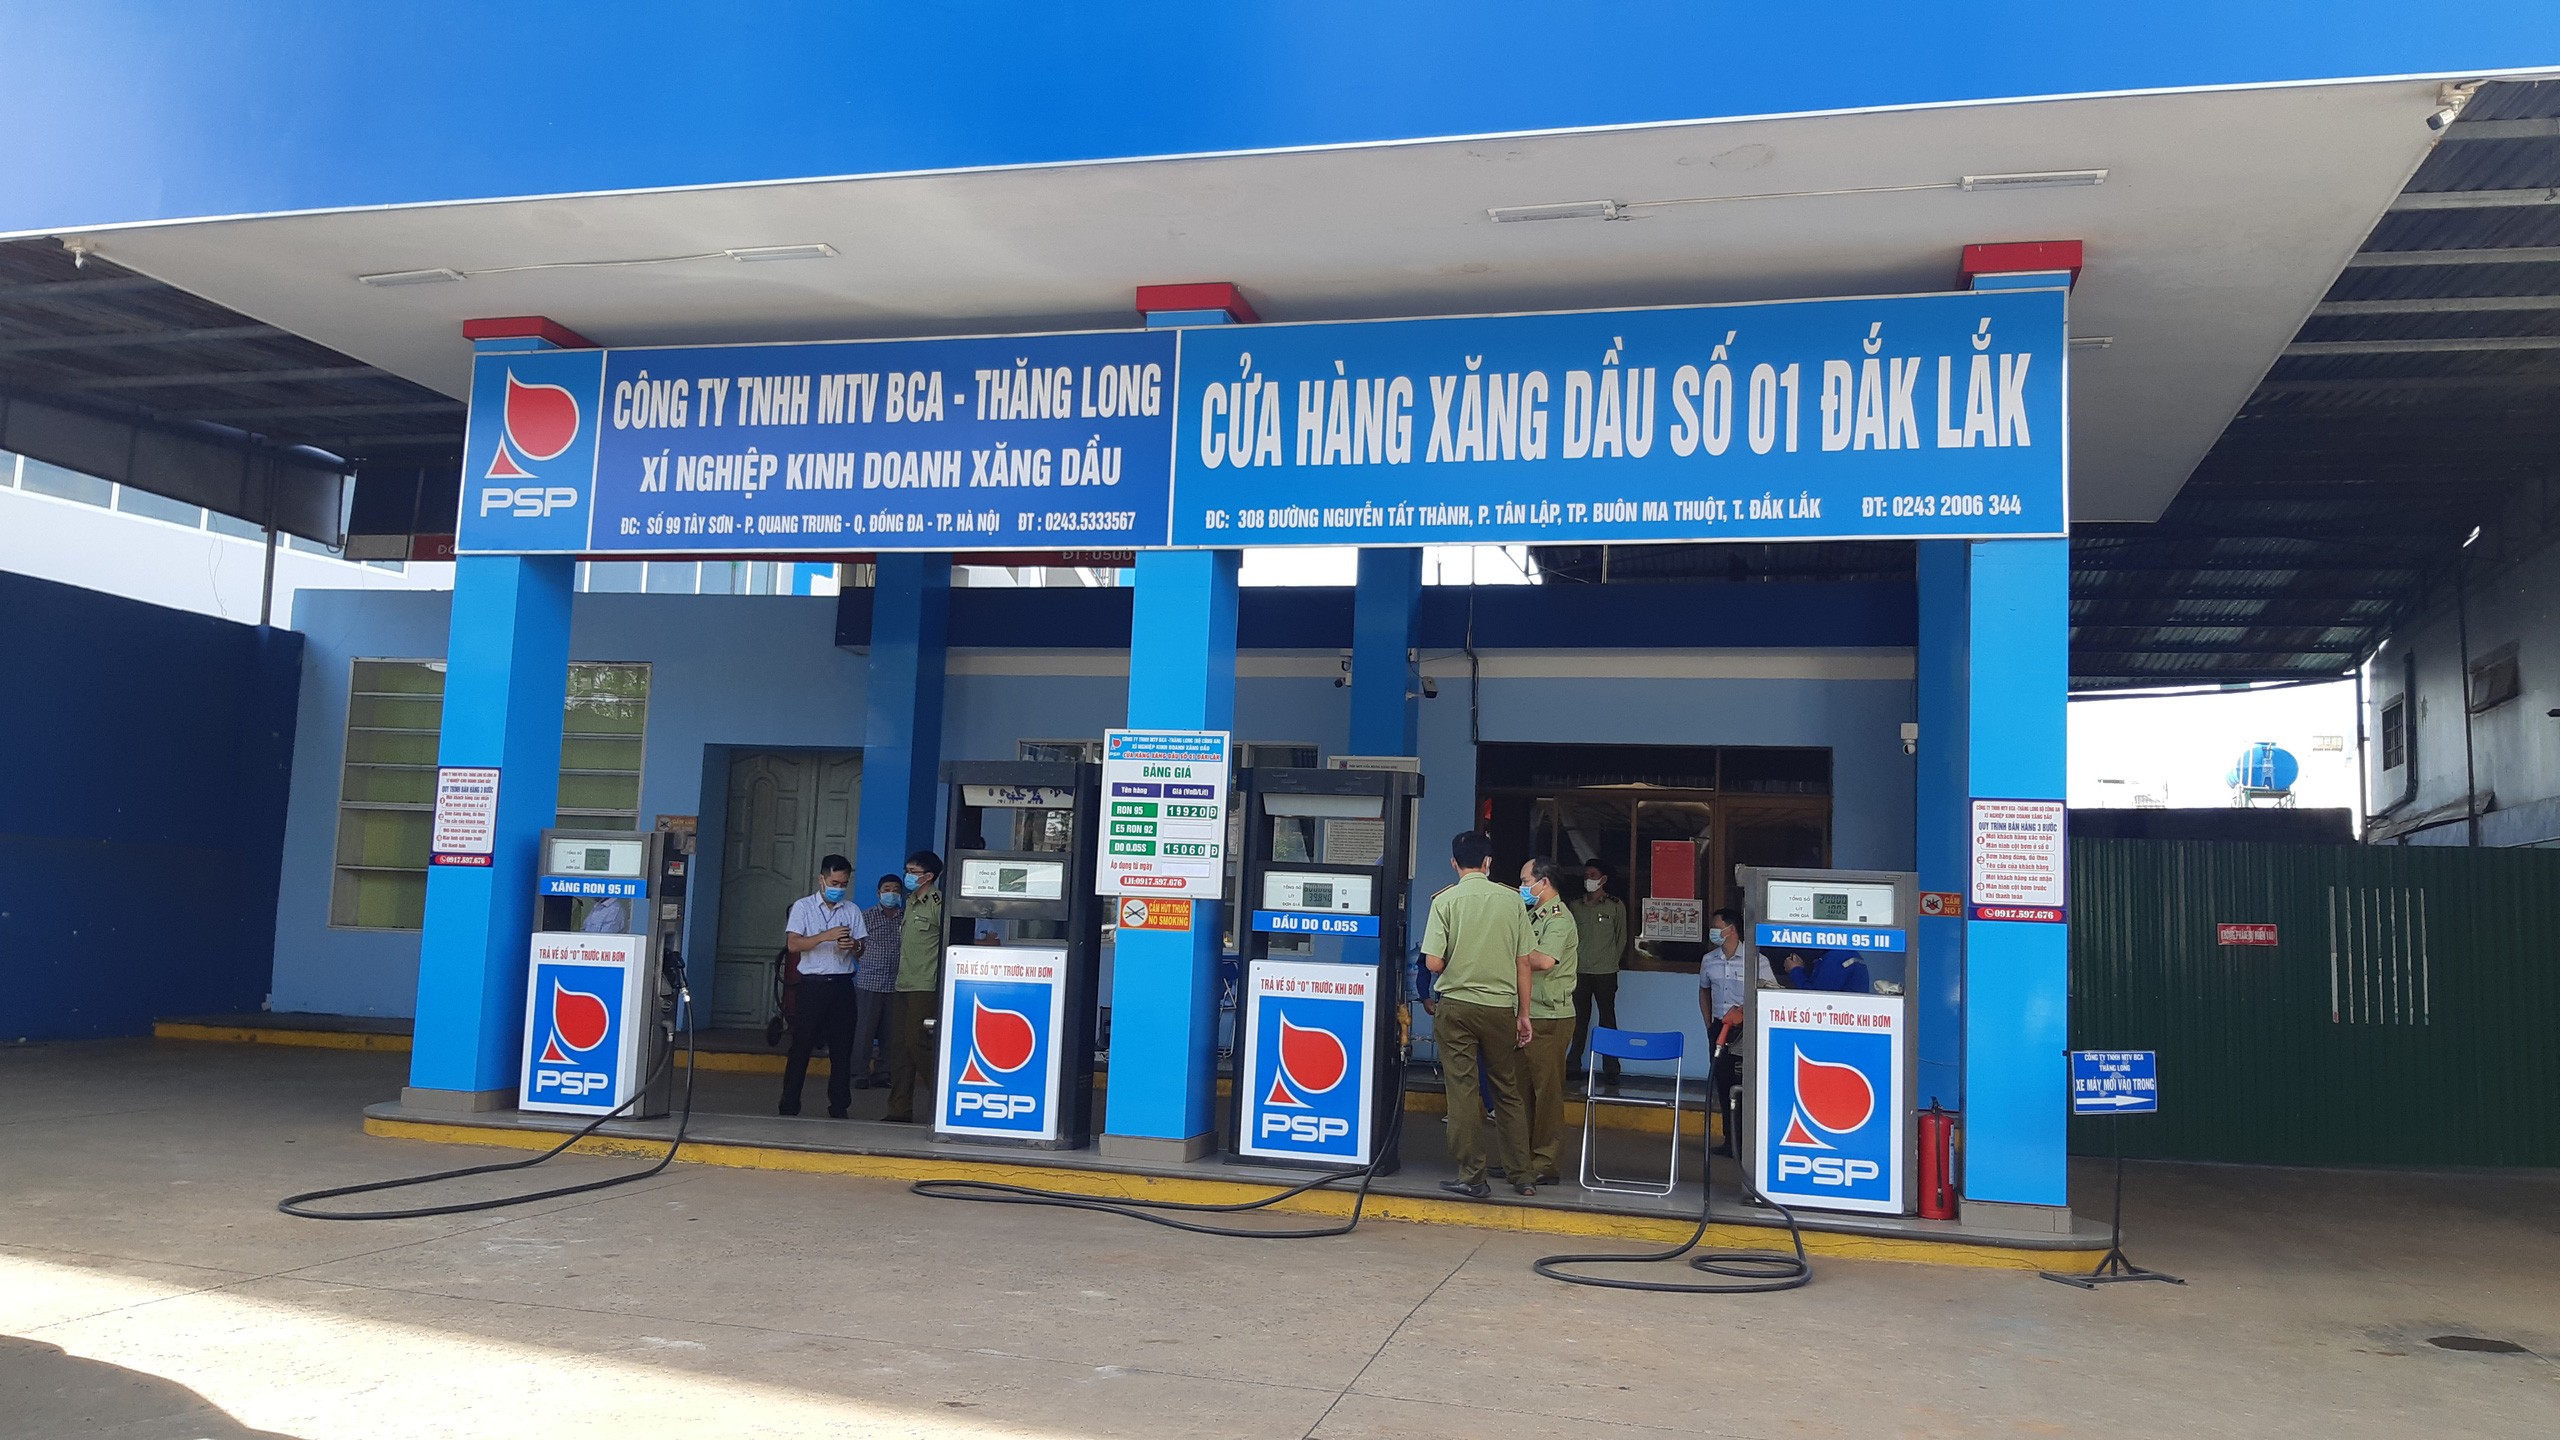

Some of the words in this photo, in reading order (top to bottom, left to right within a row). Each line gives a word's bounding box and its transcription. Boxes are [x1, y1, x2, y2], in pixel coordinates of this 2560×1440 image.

[613, 369, 689, 430] CÔNG
[698, 377, 731, 427] TY
[737, 374, 811, 427] TNHH
[818, 373, 880, 424] MTV
[886, 371, 944, 423] BCA
[975, 357, 1072, 421] THĂNG
[1081, 363, 1162, 418] LONG
[1200, 352, 1283, 469] CỬA
[1296, 360, 1414, 466] HÀNG
[1425, 354, 1549, 463] XĂNG
[1562, 337, 1656, 459] DẦU
[1669, 330, 1738, 457] SỐ
[1748, 362, 1799, 455] 01
[1820, 321, 1921, 451] ĐẮK
[1937, 317, 2032, 448] LẮK
[640, 448, 671, 492] XÍ
[675, 446, 778, 499] NGHIỆP
[786, 451, 856, 491] KINH
[862, 450, 962, 489] DOANH
[969, 441, 1052, 488] XĂNG
[1060, 433, 1122, 486] DẦU
[480, 487, 578, 517] PSP
[1205, 510, 1230, 529] ĐC:
[1237, 509, 1265, 529] 308
[1268, 503, 1319, 529] ĐƯỜNG
[1323, 499, 1382, 528] NGUYỄN
[1388, 500, 1414, 527] TẤT
[1419, 502, 1473, 528] THÀNH,
[1478, 505, 1491, 526] P.
[1495, 500, 1526, 525] TÂN
[1529, 499, 1562, 529] LẬP,
[1566, 502, 1589, 523] TP.
[1592, 498, 1638, 522] BUÔN
[1641, 500, 1669, 522] MA
[1673, 496, 1729, 525] THUỘT,
[1733, 499, 1744, 521] T.
[1748, 491, 1784, 520] ĐẮK
[1788, 489, 1821, 519] LẮK
[1862, 495, 1887, 518] ĐT:
[1892, 494, 1936, 517] 0243
[1940, 494, 1984, 516] 2006
[1988, 494, 2022, 515] 344
[620, 516, 641, 535] ĐC:
[646, 510, 664, 535] SỐ
[666, 516, 681, 534] 99
[683, 512, 707, 534] TÂY
[708, 514, 734, 534] SƠN
[744, 515, 755, 534] P.
[757, 515, 800, 534] QUANG
[802, 513, 843, 533] TRUNG
[854, 513, 866, 534] Q.
[869, 508, 904, 533] ĐỐNG
[906, 513, 924, 532] ĐA
[936, 512, 953, 532] TP.
[956, 509, 973, 532] HÀ
[977, 509, 1000, 535] NỘI
[1018, 512, 1034, 532] ĐT
[1045, 511, 1136, 532] 0243.5333567
[1143, 763, 1171, 778] BẢNG
[1174, 764, 1192, 779] GIÁ
[1116, 805, 1132, 815] RON
[1134, 806, 1144, 815] 95
[1168, 806, 1206, 817] 19920
[1115, 824, 1125, 833] E5
[1126, 824, 1142, 834] RON
[1143, 825, 1154, 834] 92
[1978, 822, 1989, 831] QUY
[1991, 820, 2007, 831] TRÌNH
[2008, 821, 2020, 831] BÁN
[2021, 821, 2036, 832] HÀNG
[2042, 822, 2058, 832] BƯỚC
[1114, 842, 1125, 852] DO
[1126, 843, 1147, 852] 0.05S
[1165, 844, 1205, 855] 15060
[551, 880, 580, 894] XĂNG
[583, 883, 606, 894] RON
[608, 884, 621, 895] 95
[624, 884, 635, 895] III
[1149, 900, 1160, 913] CẤM
[1161, 901, 1172, 913] HÚT
[1172, 900, 1189, 914] THUỐC
[1994, 909, 2054, 919] 0917.597.676
[1148, 915, 1158, 925] NO
[1159, 915, 1189, 927] SMOKING
[1272, 914, 1298, 930] DẦU
[1301, 918, 1319, 931] DO
[1322, 919, 1358, 932] 0.05S
[1771, 928, 1812, 945] XĂNG
[1816, 932, 1847, 946] RON
[1852, 934, 1870, 947] 95
[1874, 935, 1889, 947] III
[539, 945, 551, 959] TRẢ
[560, 946, 569, 960] SỐ
[582, 948, 600, 961] TRƯỚC
[601, 950, 611, 962] KHI
[612, 950, 626, 962] BƠM
[956, 960, 968, 975] TRẢ
[980, 961, 989, 976] SỐ
[1004, 963, 1024, 977] TRƯỚC
[1026, 966, 1037, 977] KHI
[1038, 966, 1053, 978] BƠM
[1261, 975, 1274, 990] TRẢ
[1286, 976, 1295, 991] SỐ
[1311, 979, 1333, 994] TRƯỚC
[1335, 983, 1347, 995] KHI
[1348, 983, 1364, 995] BƠM
[1770, 1006, 1786, 1022] TRẢ
[1799, 1007, 1810, 1023] SỐ
[1829, 1010, 1855, 1026] TRƯỚC
[1857, 1013, 1870, 1027] KHI
[1873, 1013, 1891, 1028] BƠM
[2084, 1053, 2098, 1061] CÔNG
[2099, 1063, 2117, 1072] THĂNG
[2117, 1064, 2131, 1072] LONG
[536, 1069, 608, 1096] PSP
[2075, 1079, 2085, 1092] XE
[2086, 1076, 2102, 1092] MÁY
[2117, 1075, 2132, 1091] VÀO
[2132, 1078, 2155, 1091] TRONG
[955, 1091, 1036, 1120] PSP
[1261, 1112, 1349, 1143] PSP
[1778, 1153, 1880, 1187] PSP
